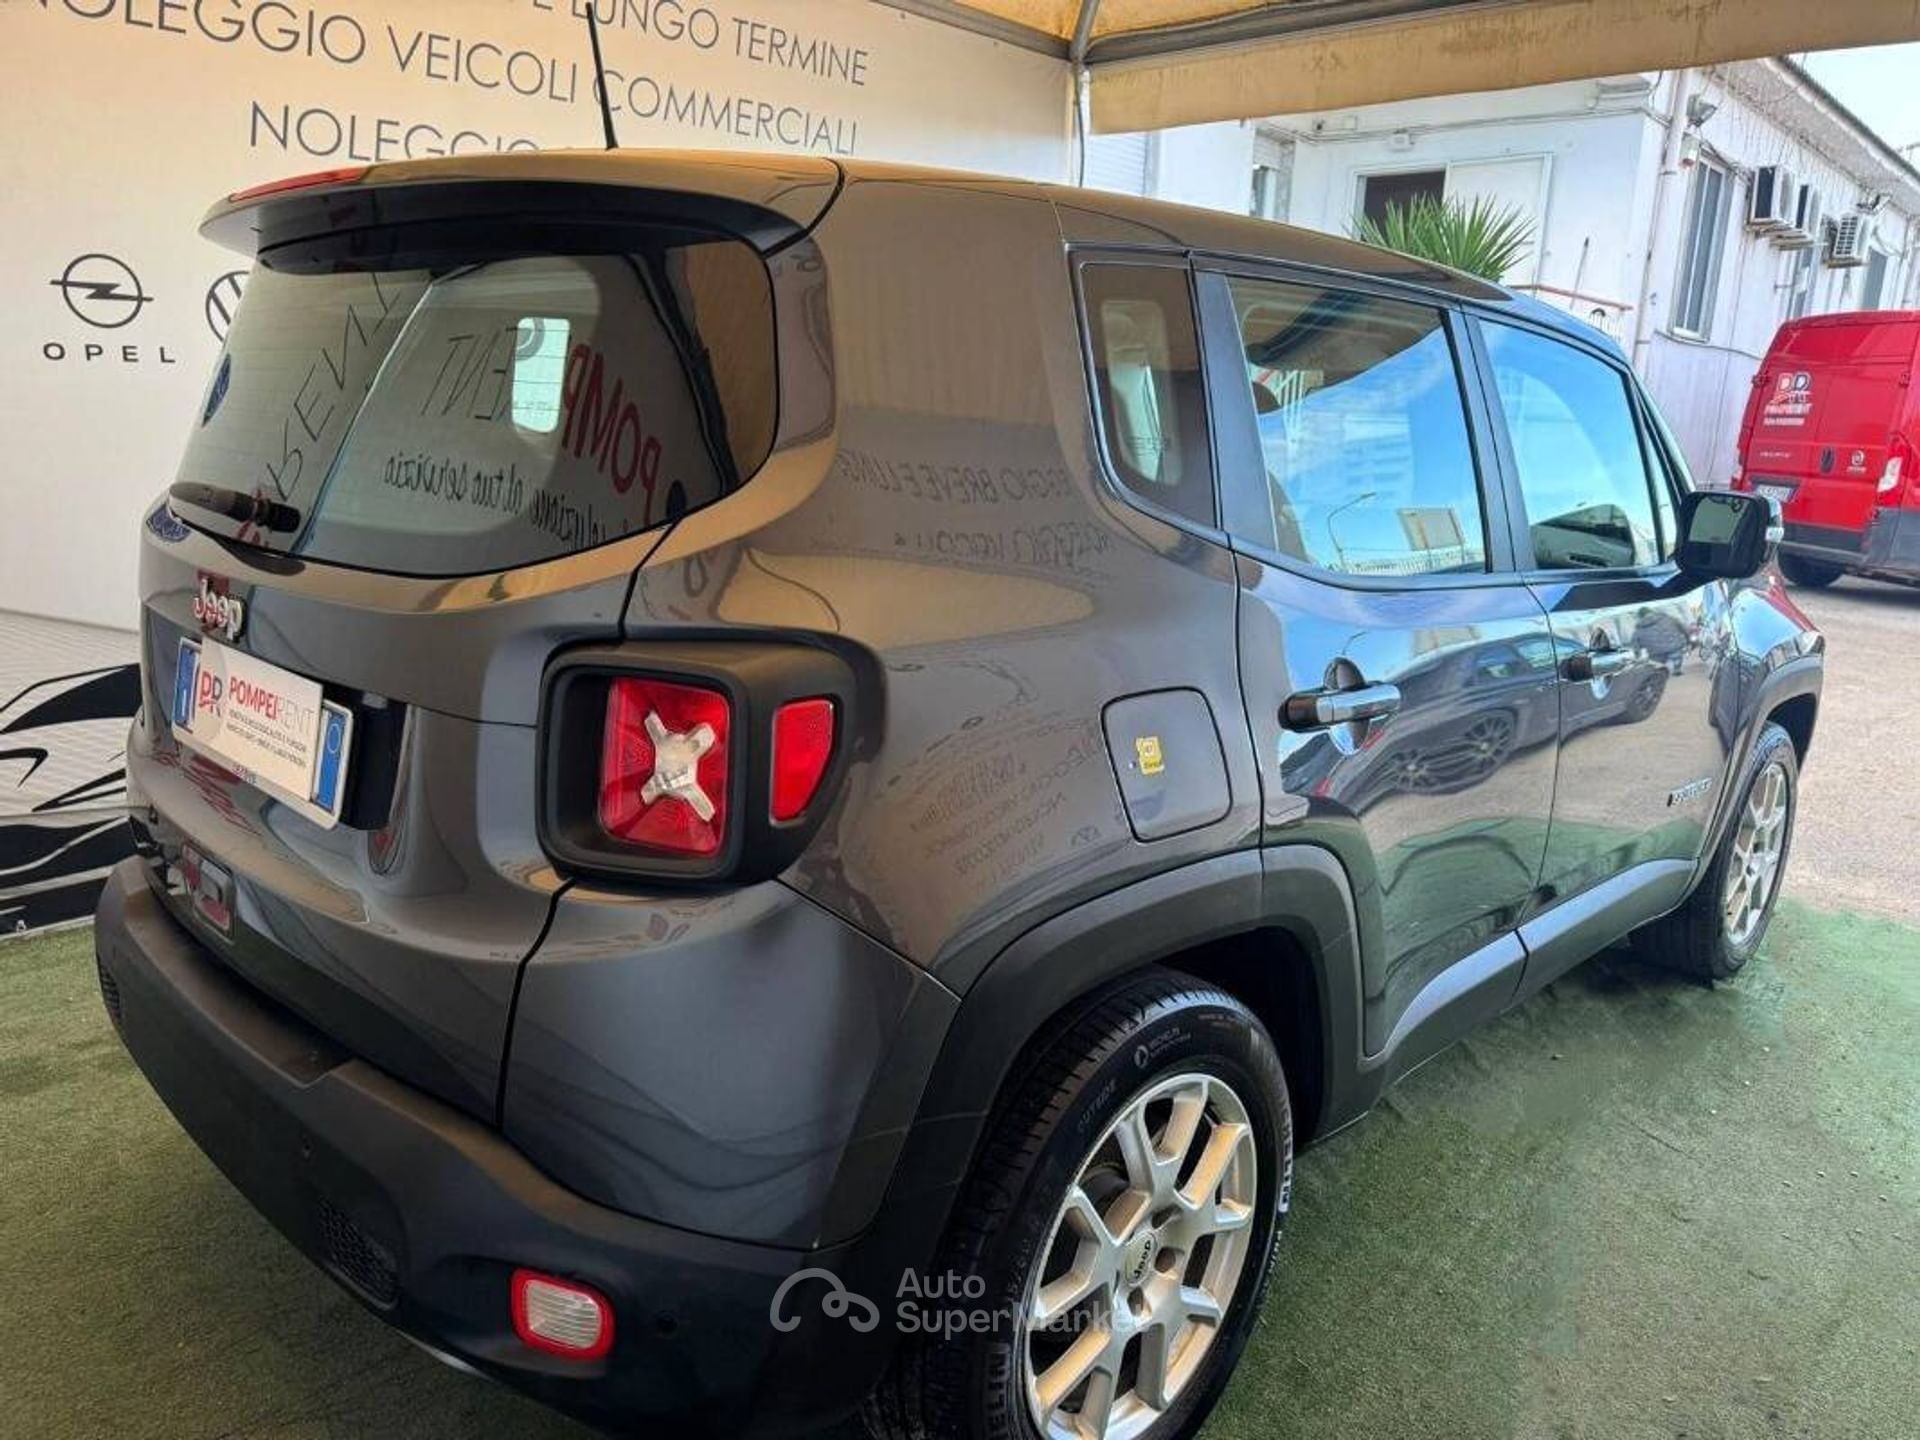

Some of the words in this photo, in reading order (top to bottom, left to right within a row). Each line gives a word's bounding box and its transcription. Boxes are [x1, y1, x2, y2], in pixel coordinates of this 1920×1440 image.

[732, 16, 868, 87] TERMINE
[387, 24, 577, 104] VEICOLI
[593, 69, 857, 155] COMMERCIALI
[42, 342, 176, 363] OPEL
[193, 577, 244, 641] Jeep
